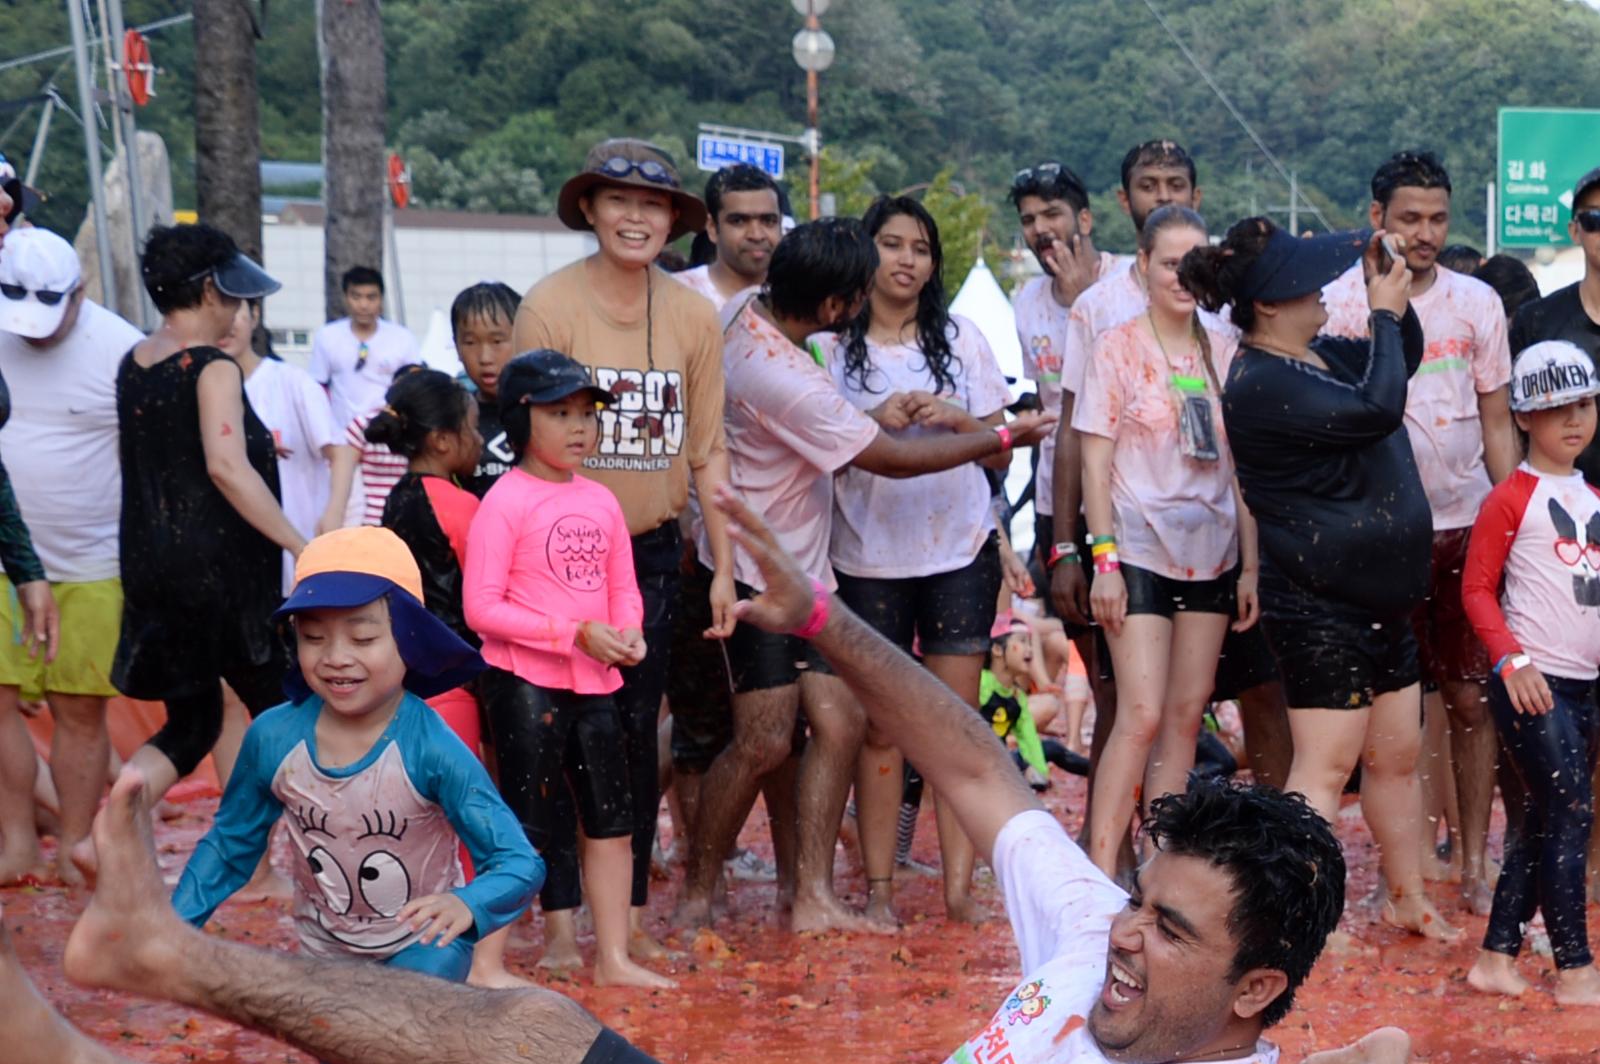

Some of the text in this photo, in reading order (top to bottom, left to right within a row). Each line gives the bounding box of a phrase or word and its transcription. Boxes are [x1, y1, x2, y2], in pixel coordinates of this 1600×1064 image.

[1507, 159, 1547, 181] 김화
[1505, 204, 1558, 224] 다목리
[1521, 363, 1590, 400] DRUNKEN
[595, 410, 684, 456] IEW
